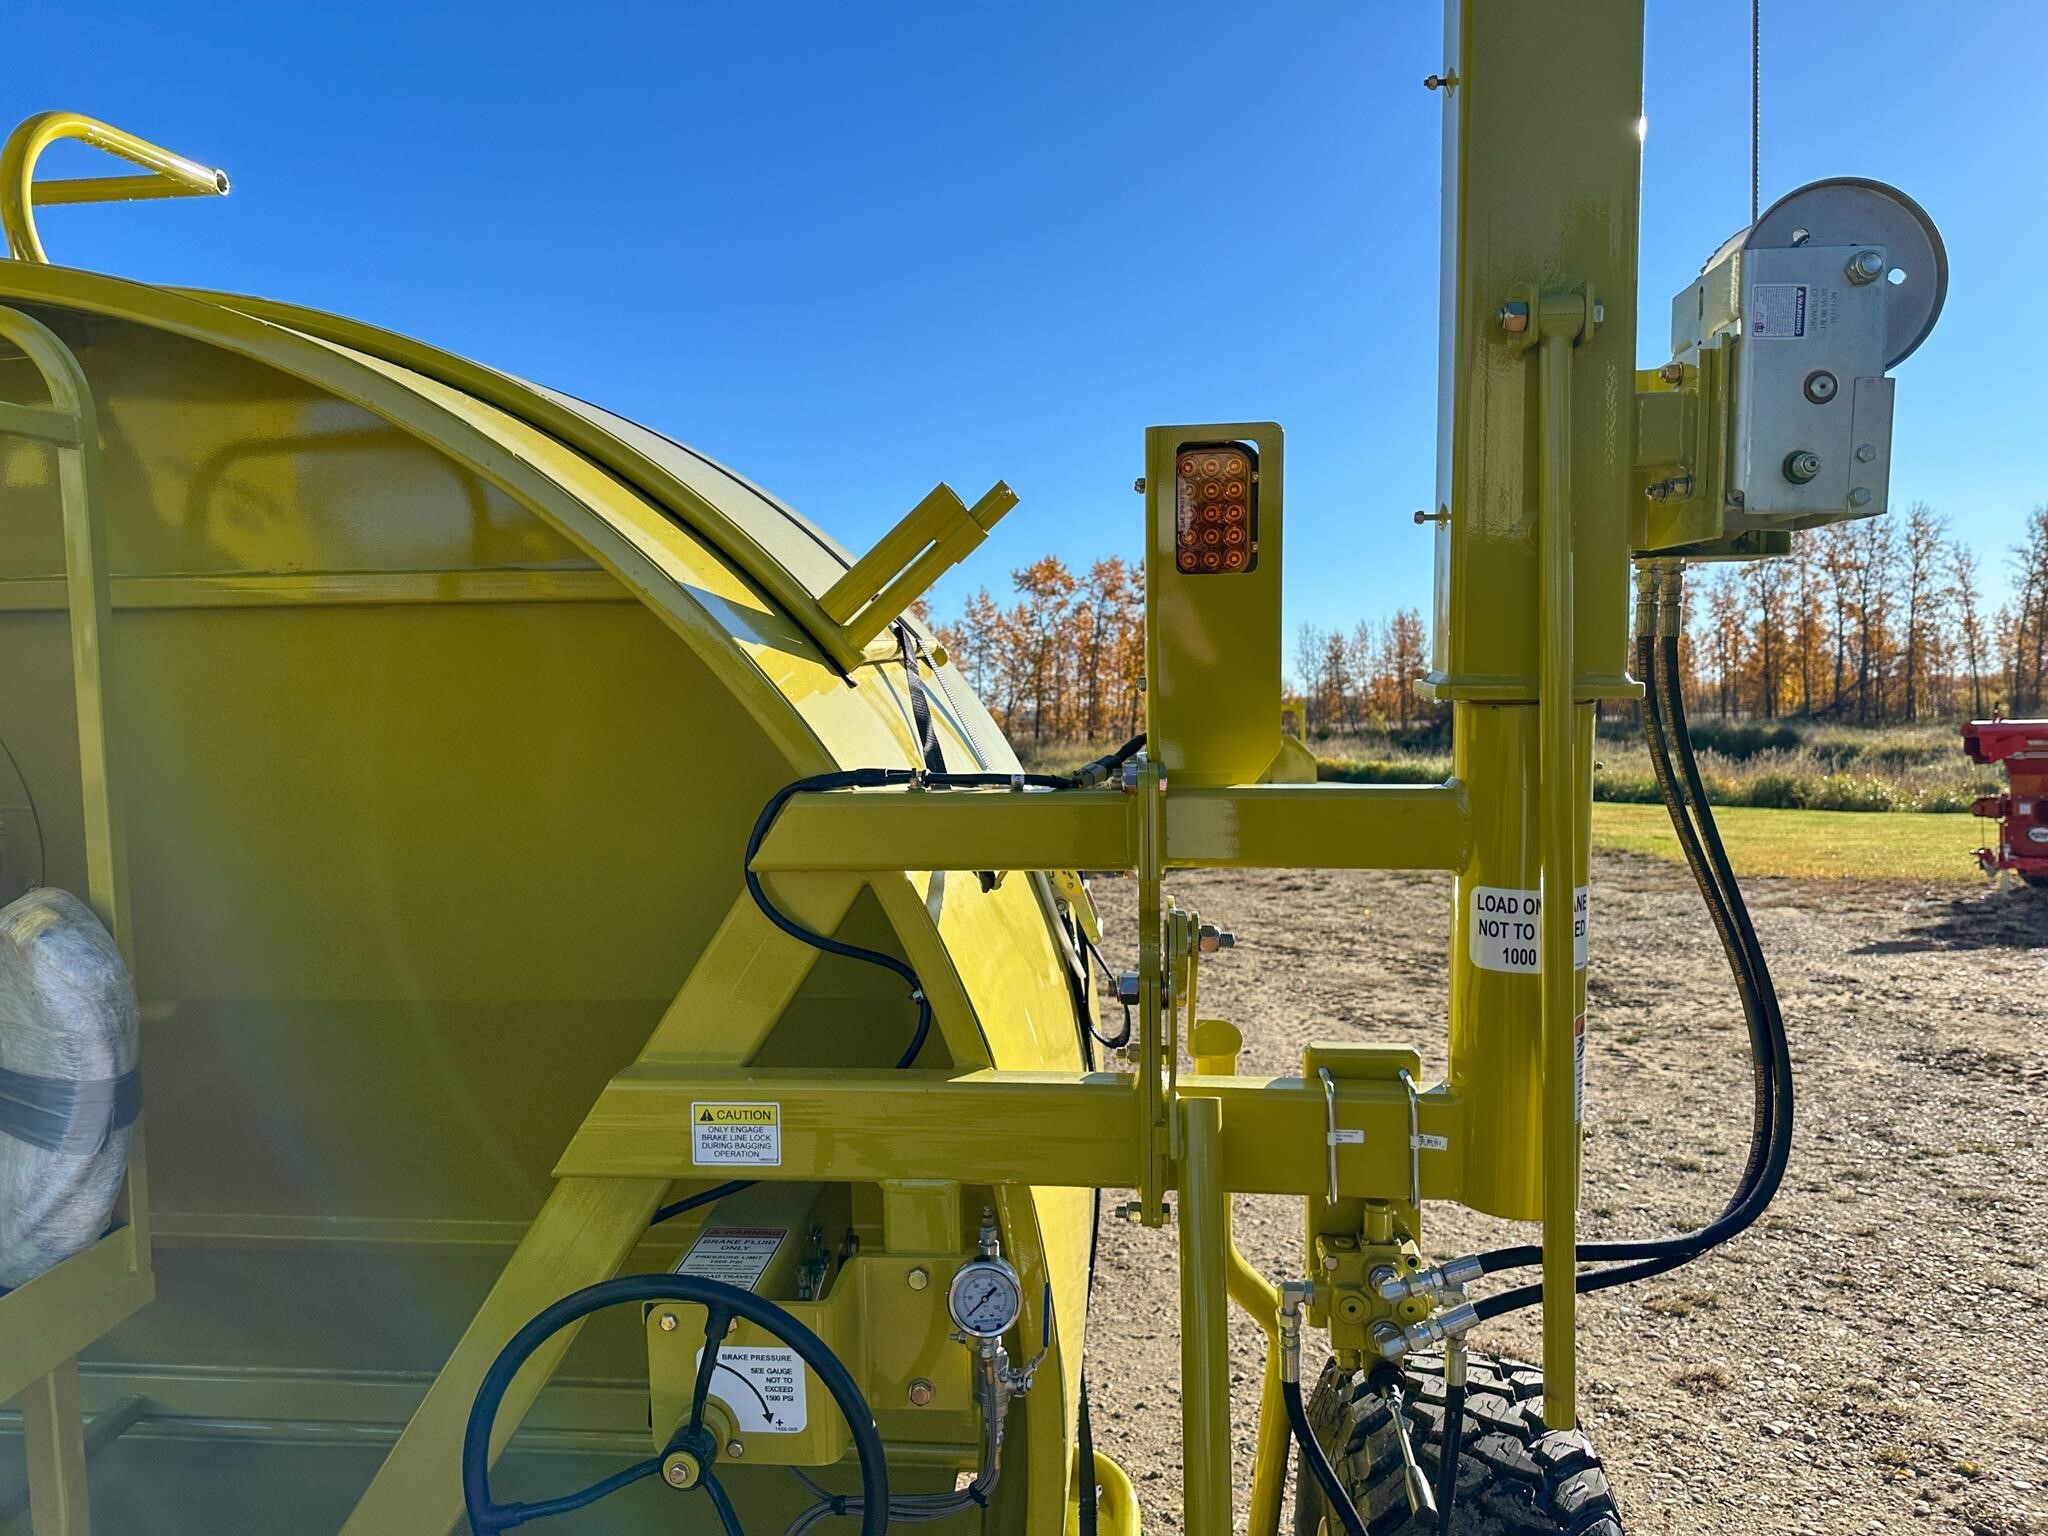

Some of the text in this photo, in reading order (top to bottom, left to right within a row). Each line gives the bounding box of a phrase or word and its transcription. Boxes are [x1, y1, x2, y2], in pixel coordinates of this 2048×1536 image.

[1795, 296, 1804, 335] WARNING
[1477, 894, 1518, 914] LOAD
[1479, 919, 1535, 940] NOT TO
[1503, 947, 1536, 965] 1000
[716, 1110, 771, 1120] CAUTION
